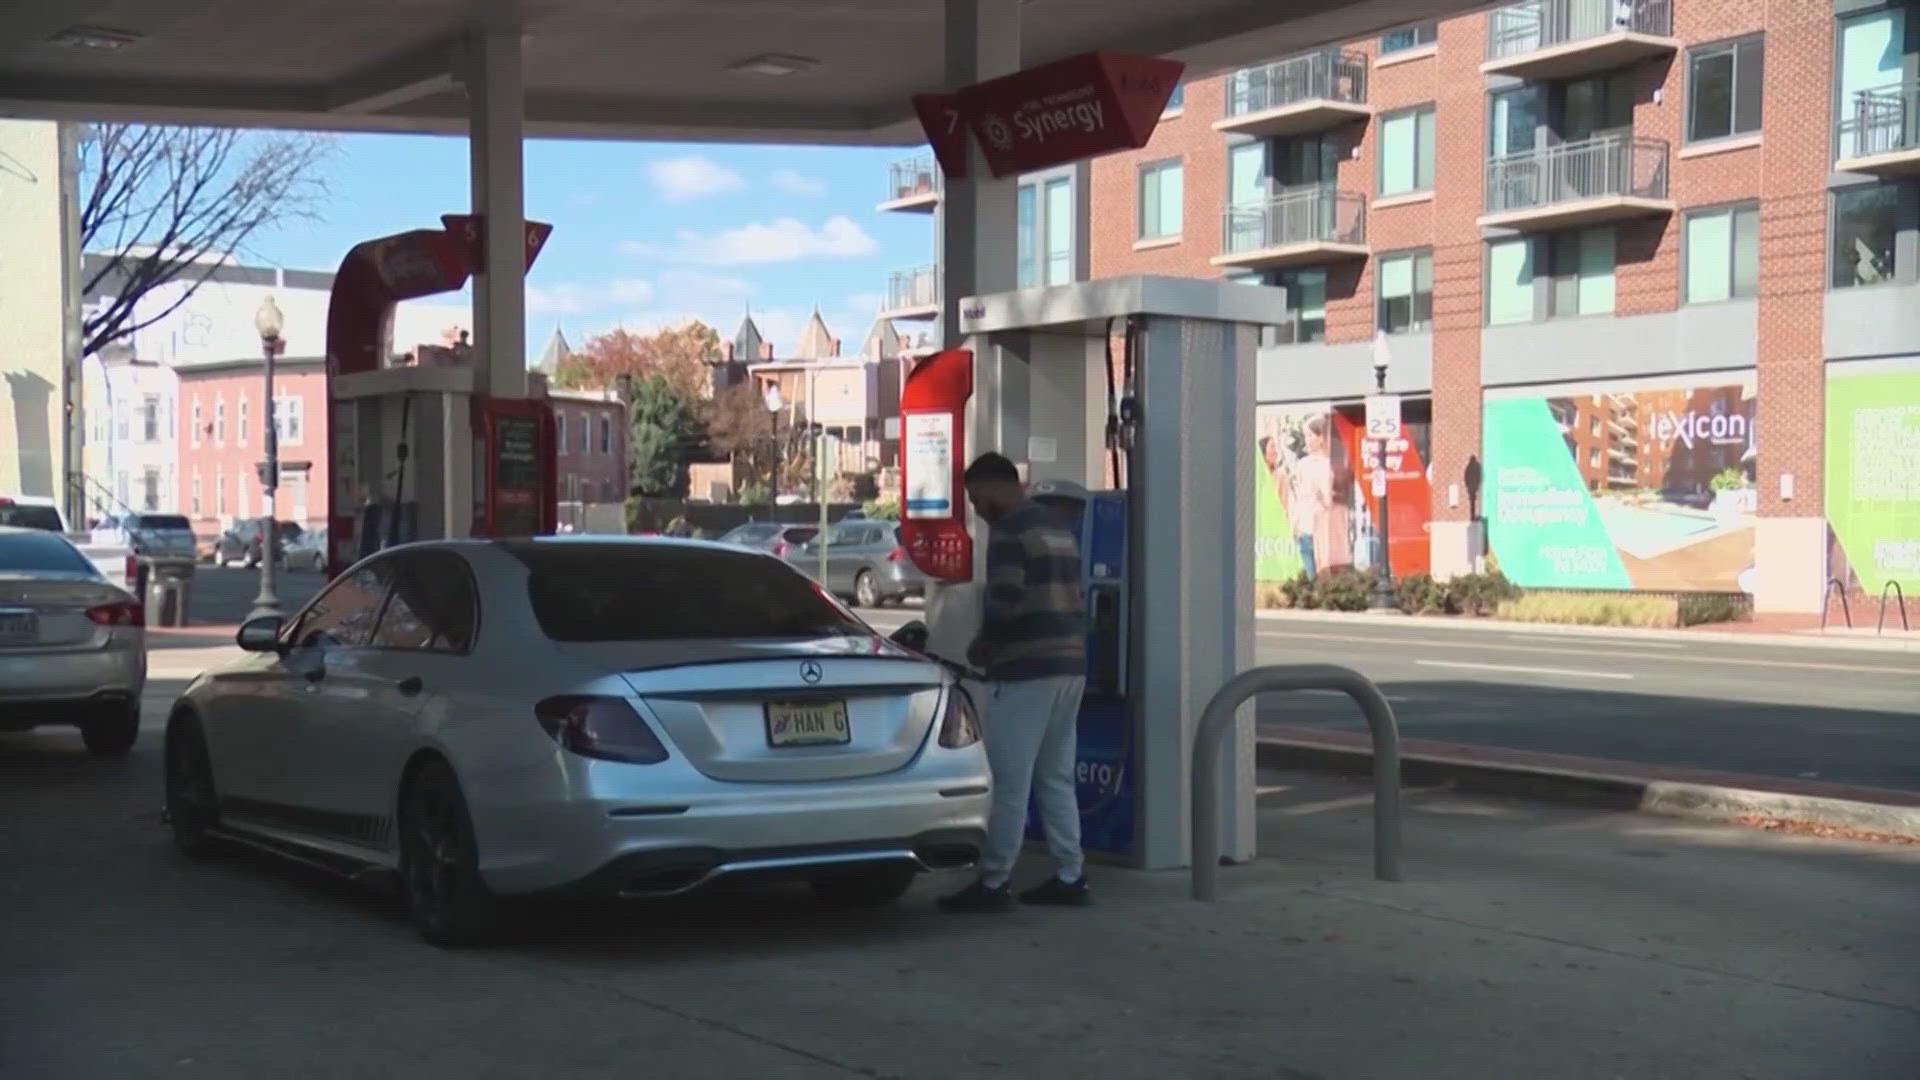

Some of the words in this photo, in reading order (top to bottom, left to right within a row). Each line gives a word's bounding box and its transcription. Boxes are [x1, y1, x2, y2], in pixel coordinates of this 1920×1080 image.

[945, 109, 959, 135] 7
[1013, 97, 1104, 143] Synergy
[528, 229, 539, 246] 6
[1370, 418, 1397, 434] 25
[1649, 410, 1745, 450] lexicon
[793, 711, 825, 733] HAN
[833, 710, 845, 733] G
